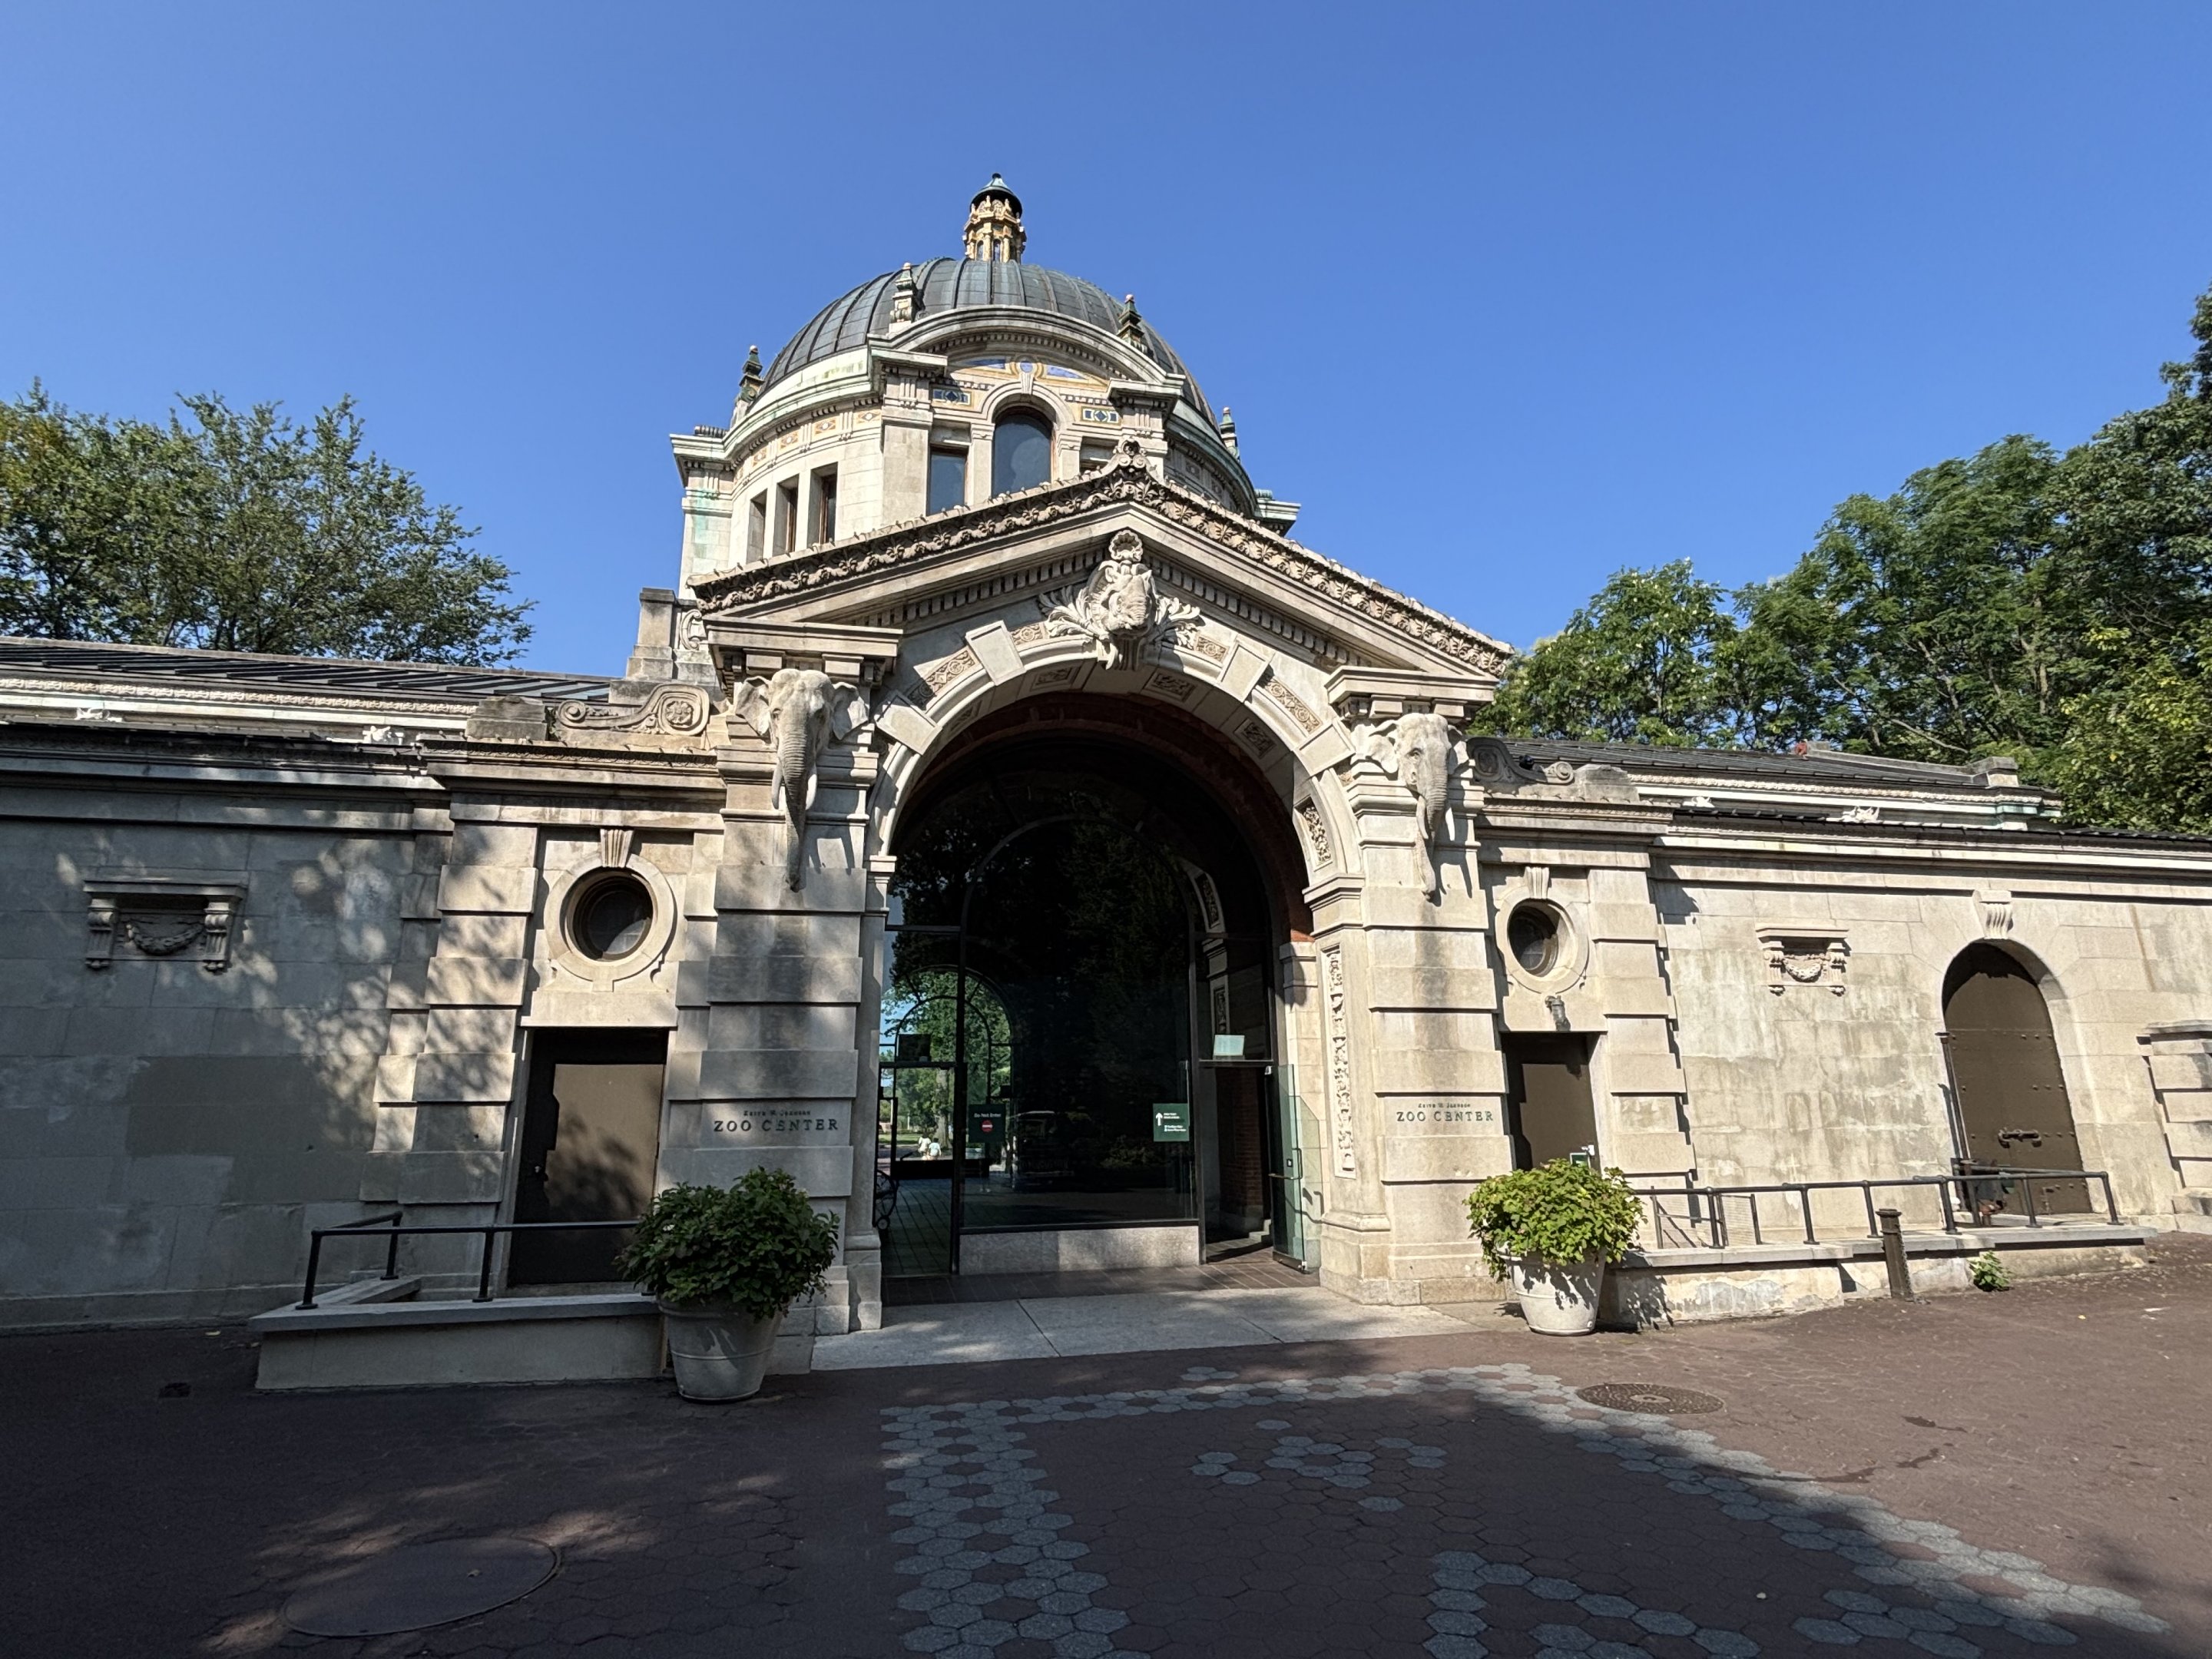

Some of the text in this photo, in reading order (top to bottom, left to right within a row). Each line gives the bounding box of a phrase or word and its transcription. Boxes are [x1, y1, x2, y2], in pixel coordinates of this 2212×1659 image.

[1396, 1111, 1494, 1121] ZOO CENTER
[713, 1118, 839, 1132] ZOO CENTER
